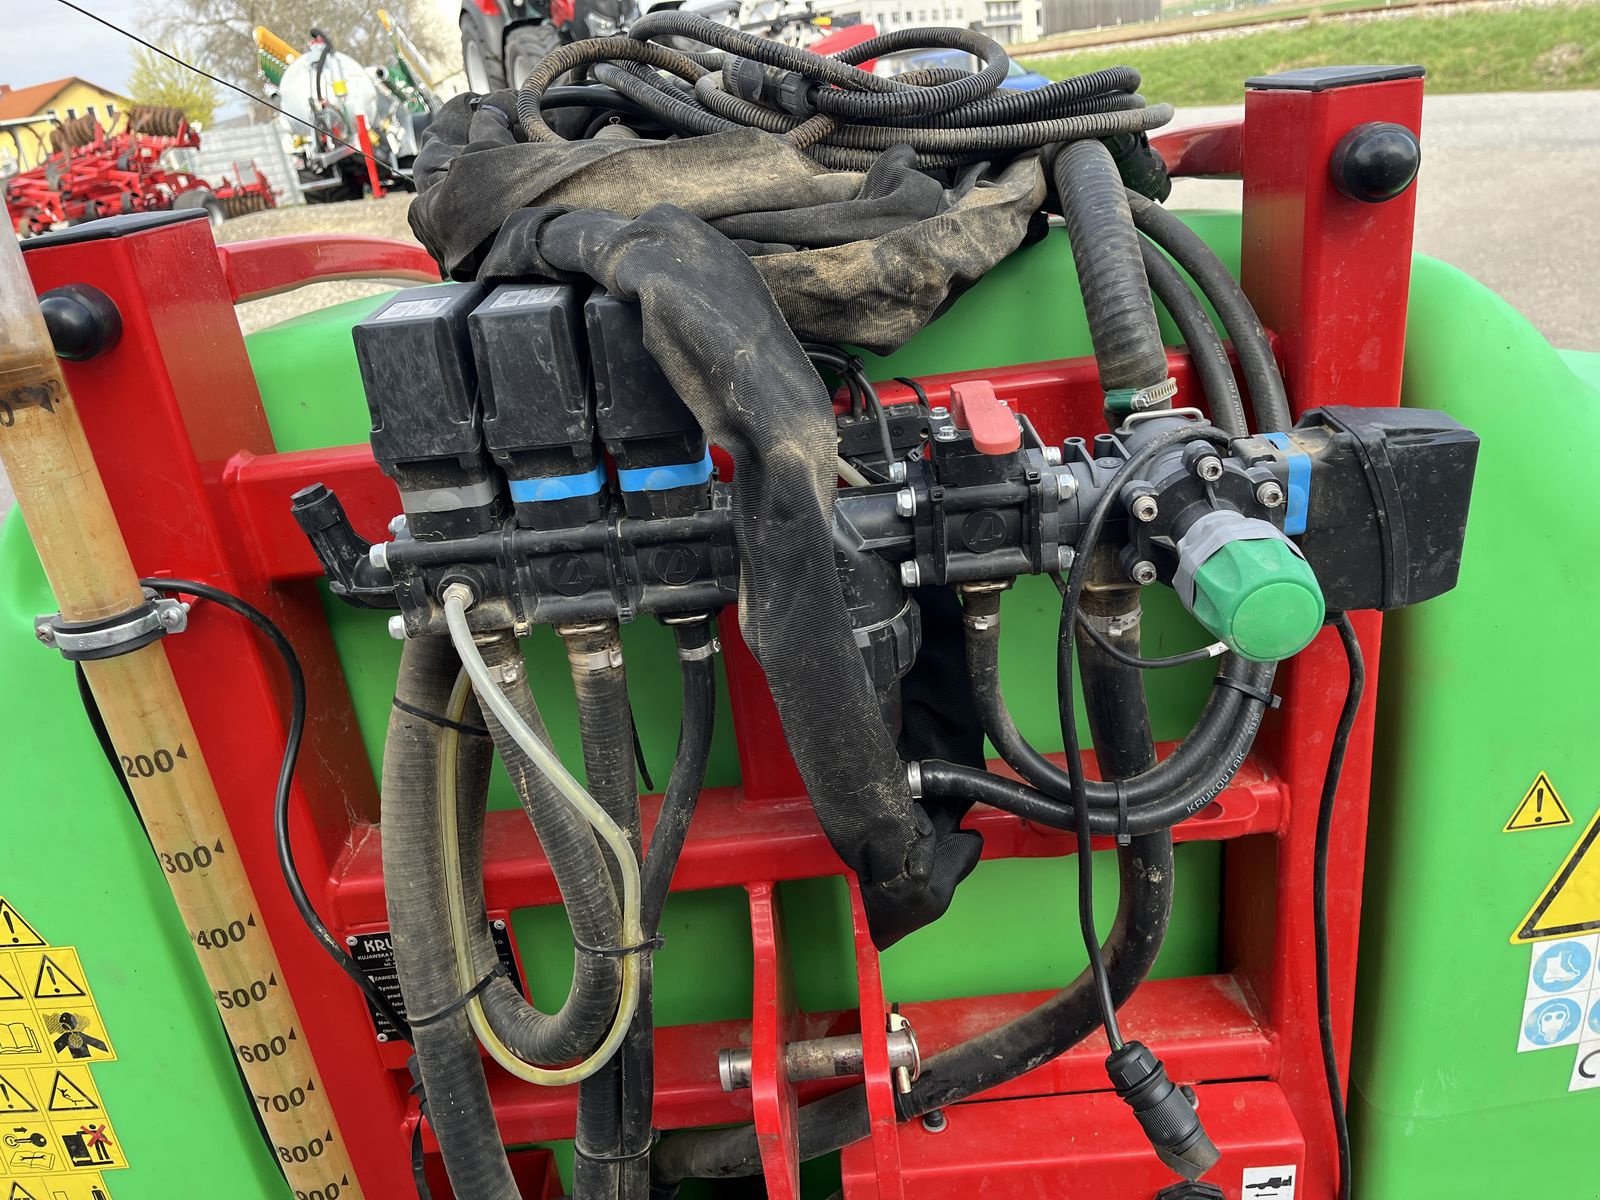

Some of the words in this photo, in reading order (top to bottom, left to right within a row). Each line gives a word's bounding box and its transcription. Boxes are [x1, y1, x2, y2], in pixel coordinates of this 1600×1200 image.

[122, 748, 175, 779] 200
[1186, 750, 1246, 814] KRUKOWIAK
[160, 845, 212, 874] 300
[196, 920, 247, 951] 400
[217, 980, 268, 1010] 500
[238, 1035, 288, 1064] 600
[257, 1086, 306, 1114] 700
[278, 1136, 324, 1164] 800
